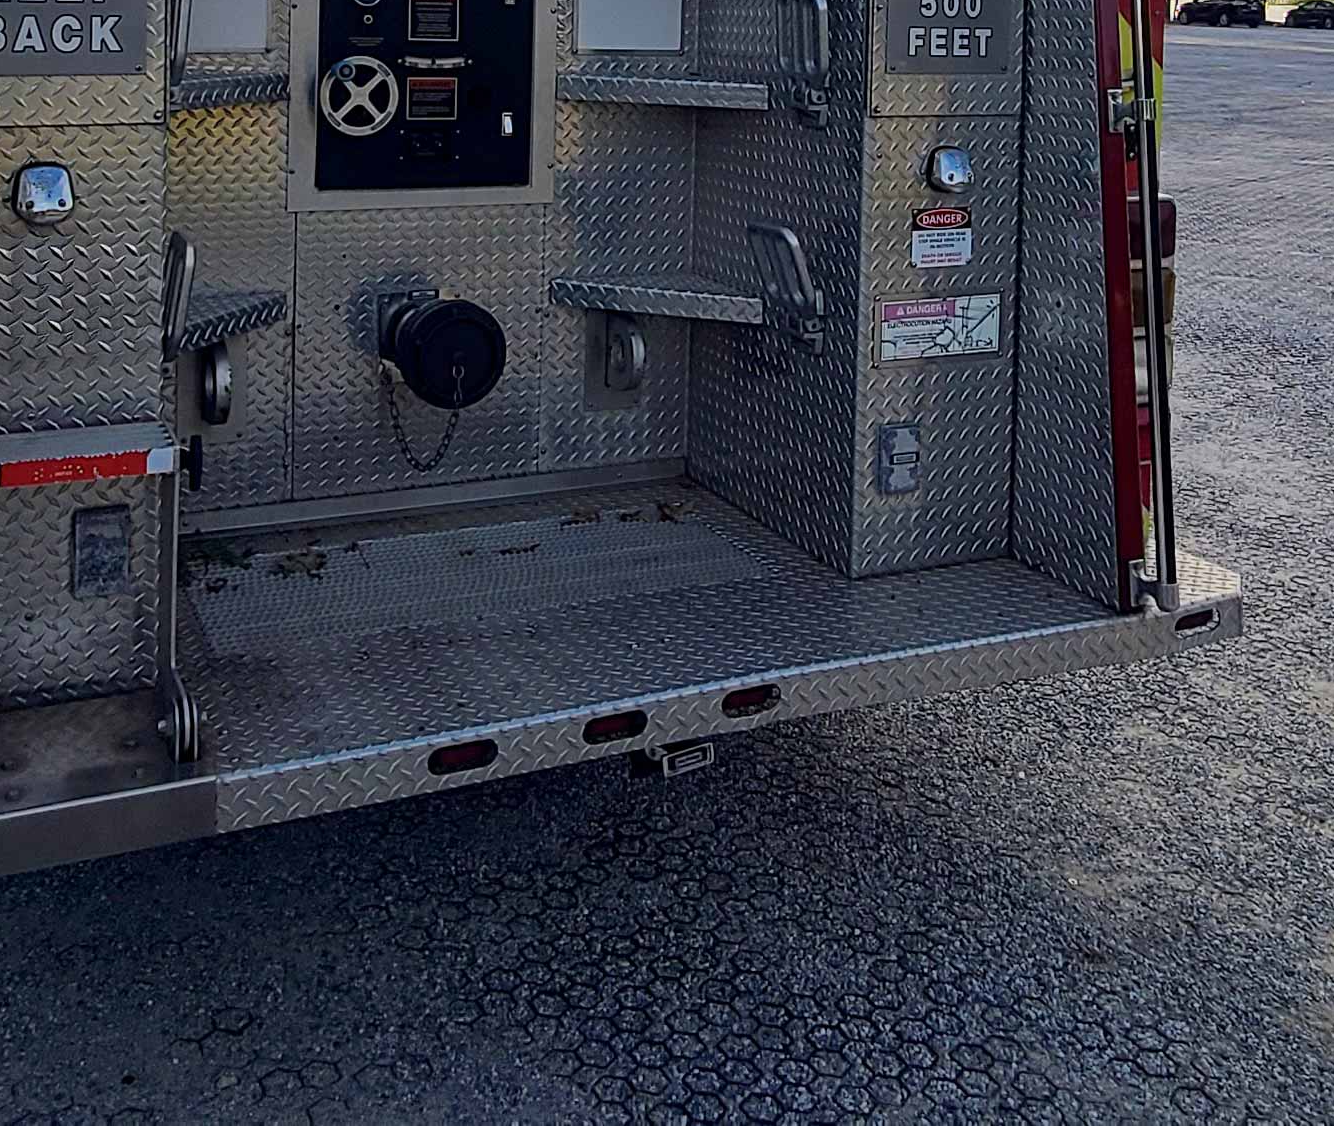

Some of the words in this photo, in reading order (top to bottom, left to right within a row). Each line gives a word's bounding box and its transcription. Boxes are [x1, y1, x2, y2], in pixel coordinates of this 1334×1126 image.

[908, 26, 993, 58] FEET
[922, 213, 962, 225] DANGER
[906, 304, 942, 315] DANGER
